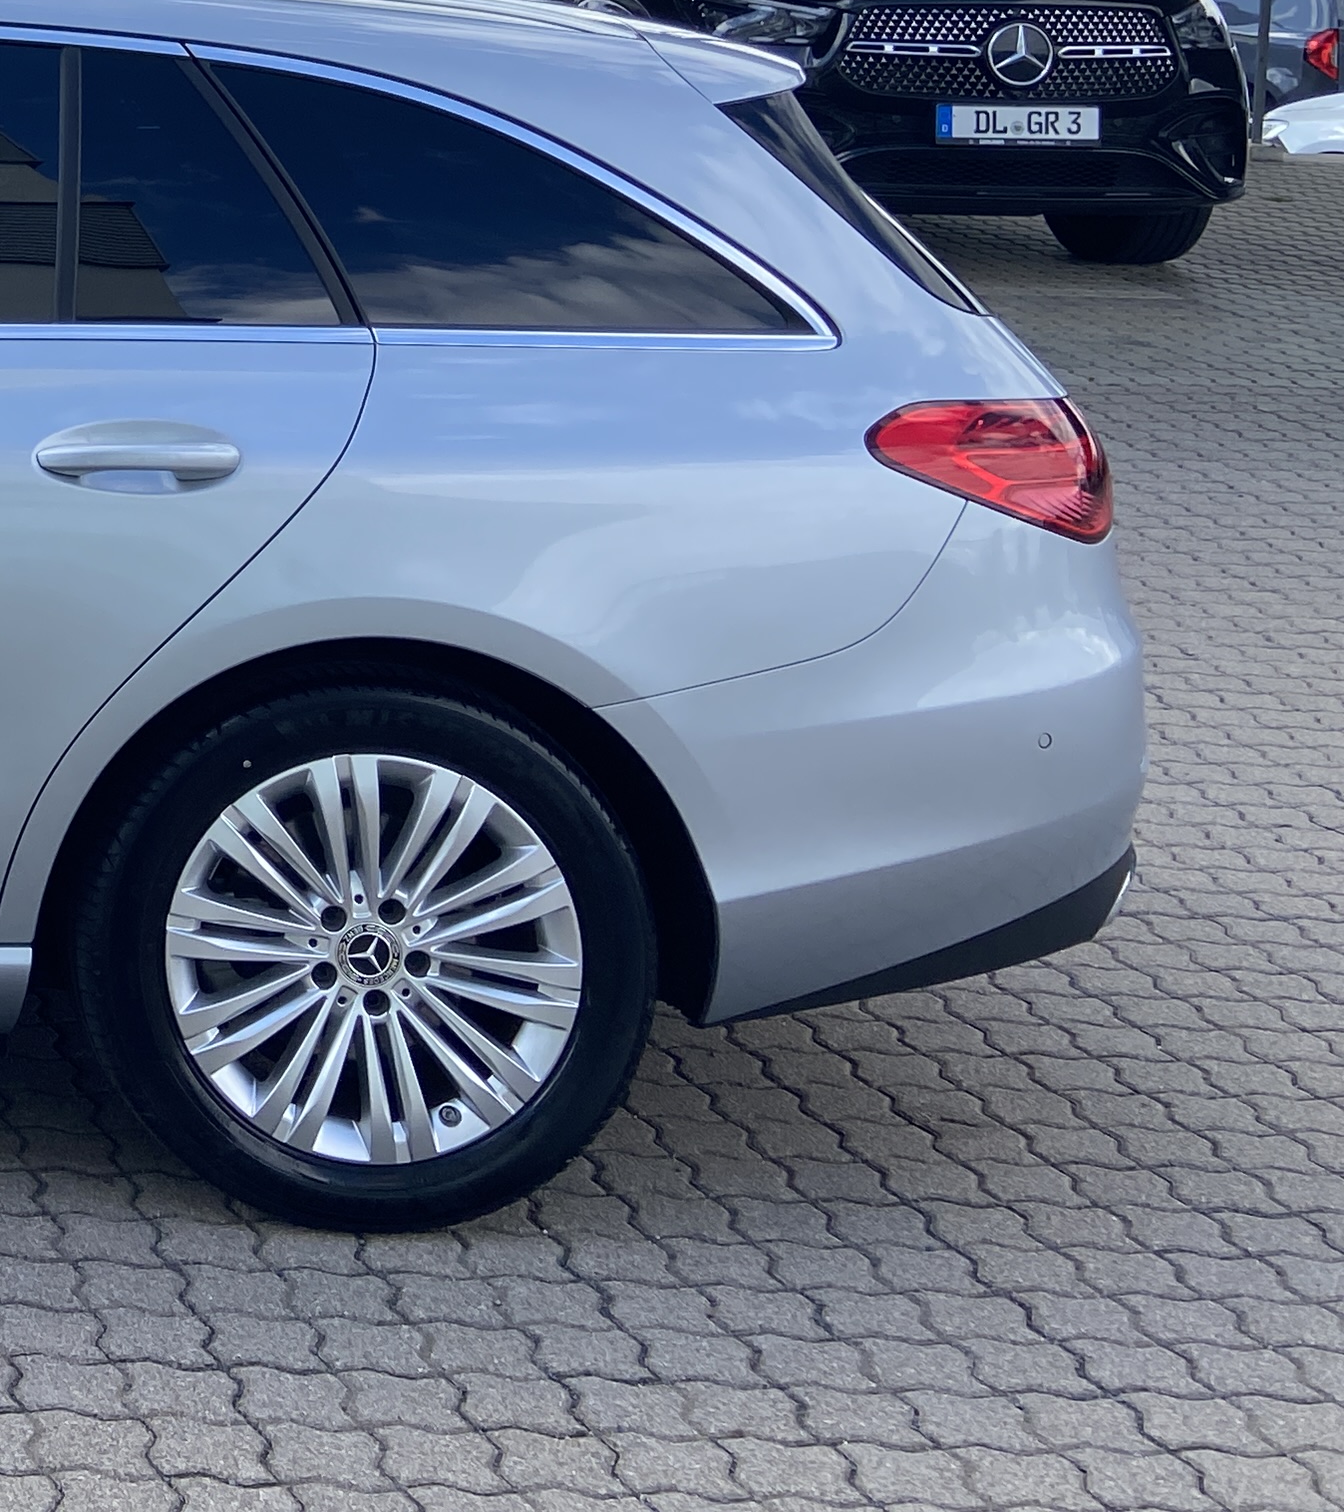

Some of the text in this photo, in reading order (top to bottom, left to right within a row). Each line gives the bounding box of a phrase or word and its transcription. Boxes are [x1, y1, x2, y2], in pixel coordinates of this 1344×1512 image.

[973, 110, 1082, 136] DL GR 3
